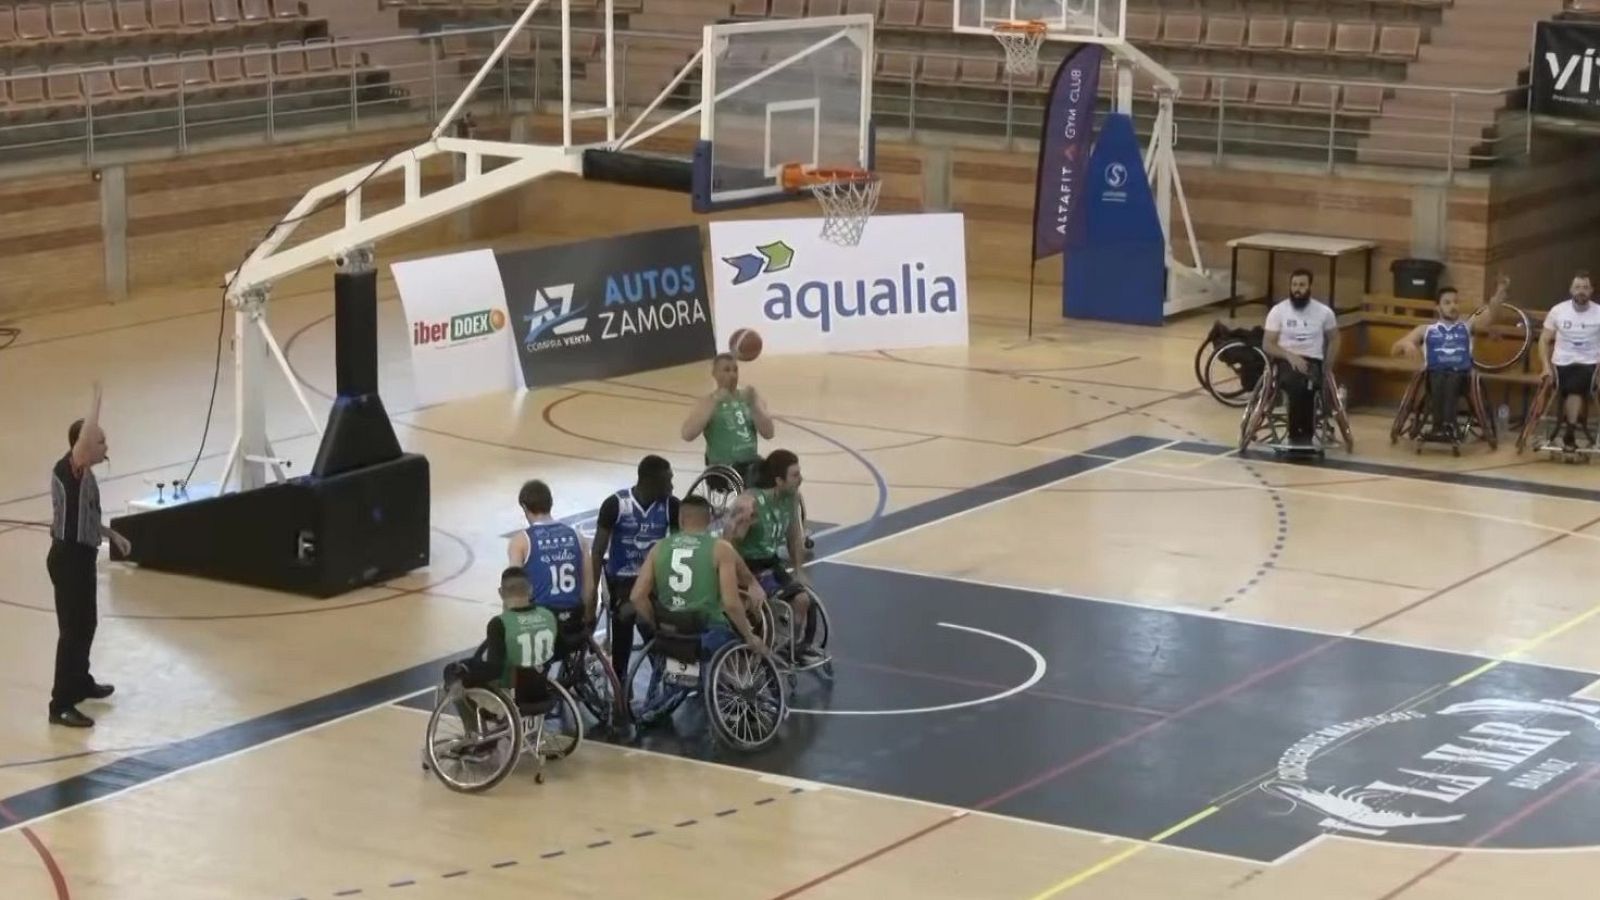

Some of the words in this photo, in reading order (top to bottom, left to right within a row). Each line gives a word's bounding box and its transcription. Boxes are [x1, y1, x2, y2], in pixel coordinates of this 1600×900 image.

[1070, 69, 1082, 103] CLUB
[1065, 108, 1077, 139] GYM
[1056, 166, 1073, 235] ALTAFIT
[604, 264, 698, 307] AUTOS
[763, 261, 958, 332] aqualia
[413, 321, 449, 346] iber
[598, 298, 707, 340] ZAMORA
[526, 338, 562, 353] COMPRA
[563, 333, 592, 347] VENTA
[549, 563, 576, 595] 16
[668, 548, 694, 593] 5
[516, 629, 554, 668] 10
[1421, 721, 1572, 772] MAR
[1363, 767, 1493, 803] LA
